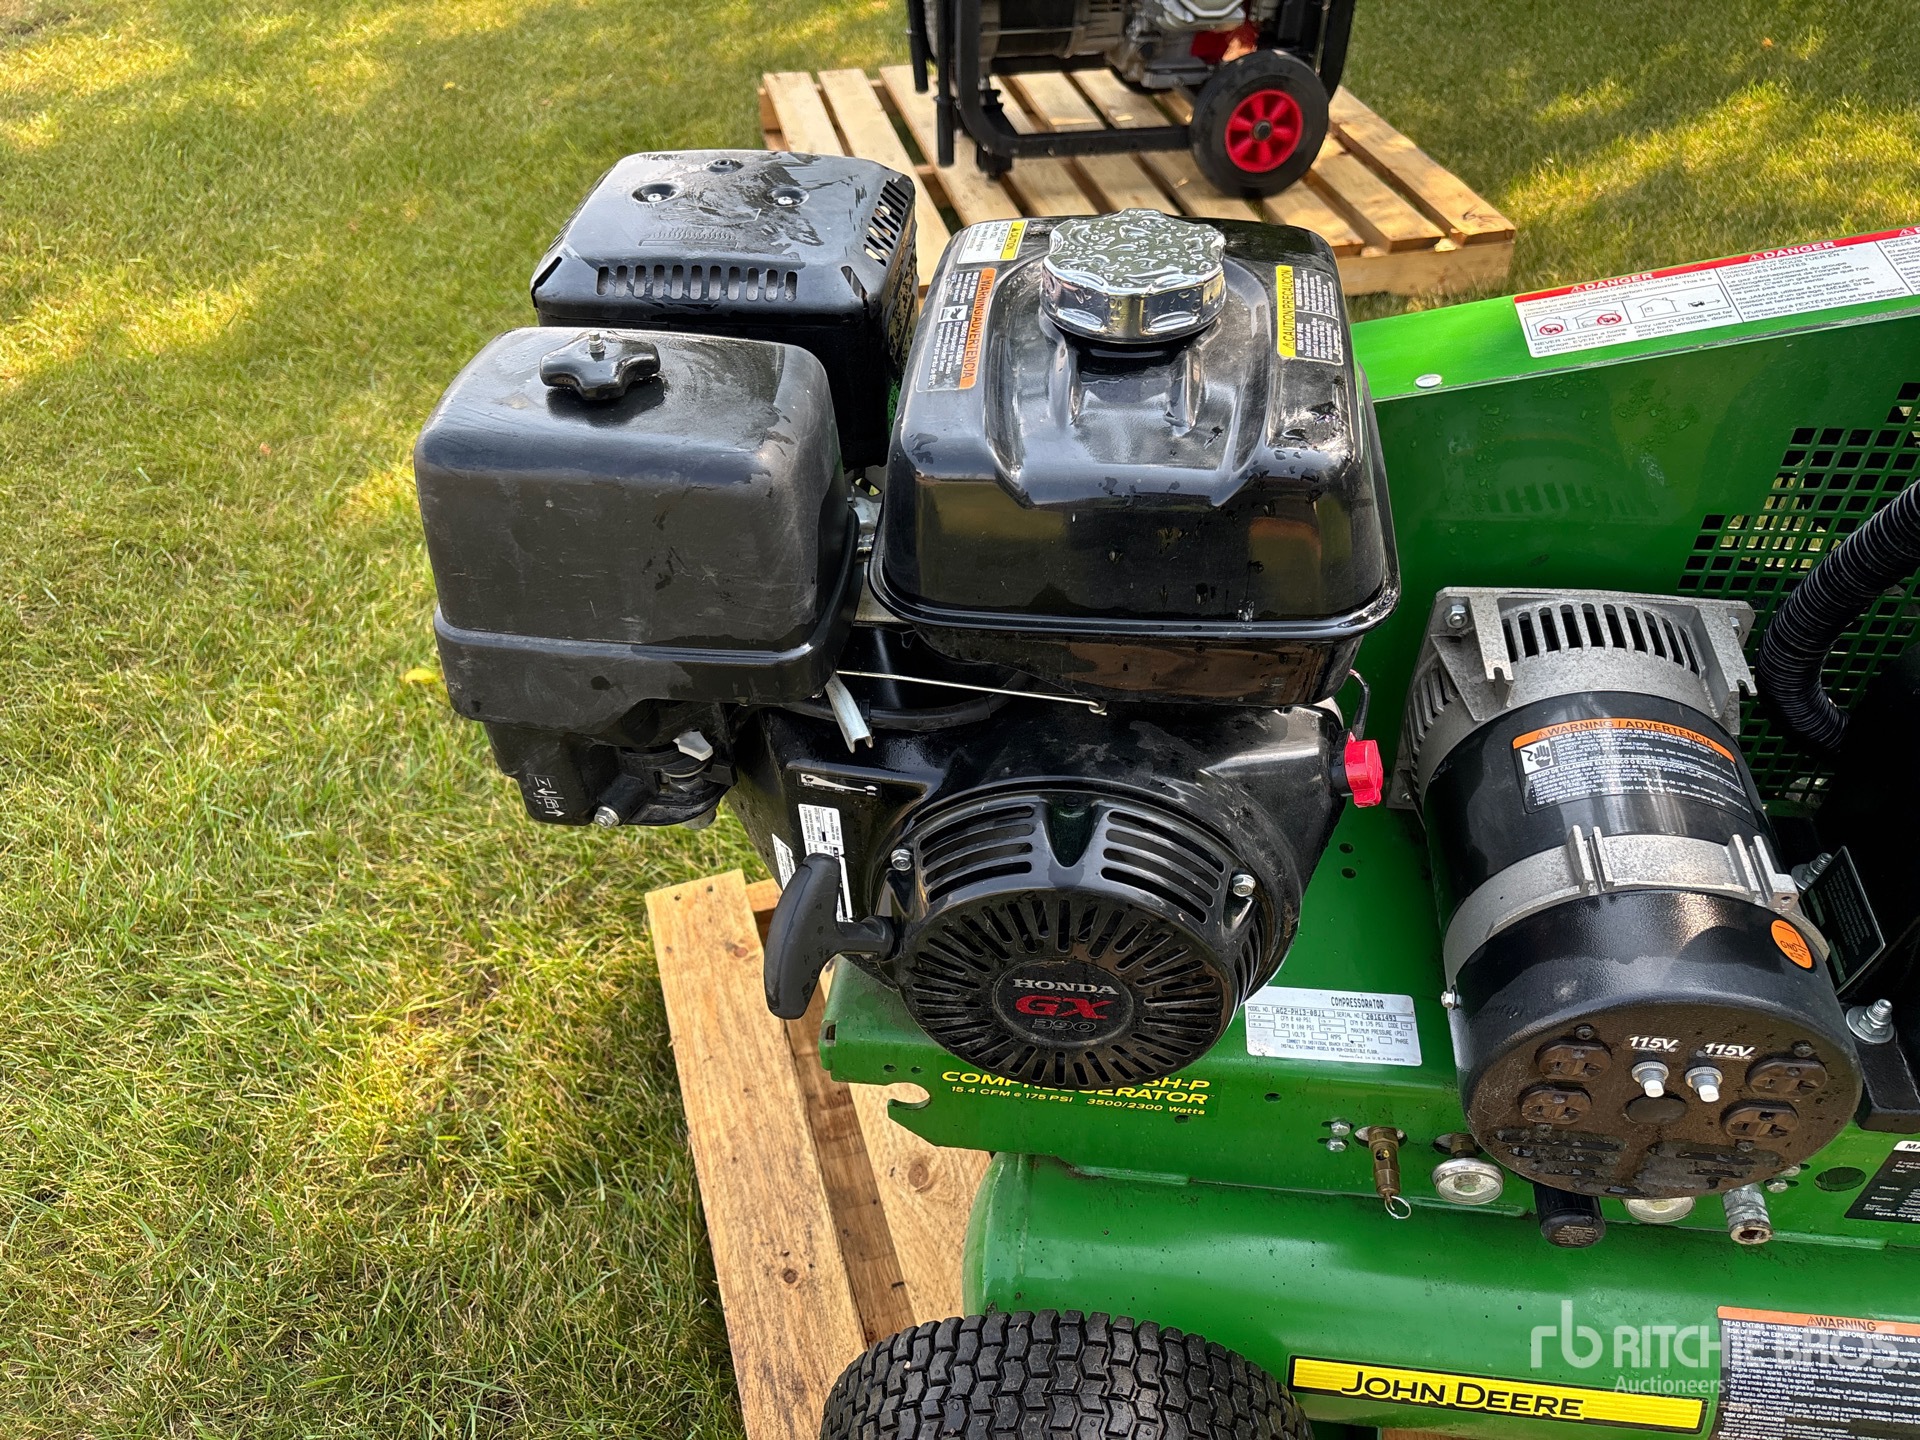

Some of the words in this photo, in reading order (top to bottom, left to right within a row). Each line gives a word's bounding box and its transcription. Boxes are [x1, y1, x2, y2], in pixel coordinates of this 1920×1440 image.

[1763, 242, 1836, 258] DANGER
[1584, 273, 1654, 290] DANGER
[1547, 720, 1614, 736] WARNING
[1625, 720, 1714, 749] ADVERTENCIA
[1780, 940, 1798, 952] GND
[1013, 978, 1120, 996] HONDA
[1015, 995, 1115, 1020] GX
[1330, 996, 1384, 1010] COMPRESSORATOR
[1032, 1018, 1096, 1032] 390
[1630, 1036, 1678, 1050] 115V
[1704, 1043, 1755, 1057] 115V
[980, 1088, 1010, 1097] CFM
[1049, 1094, 1074, 1102] PSI
[1086, 1098, 1164, 1111] 3500/2300
[1168, 1106, 1206, 1115] Watts
[1742, 1322, 1766, 1330] ENTIRE
[1766, 1323, 1808, 1334] INSTRUCTION
[1810, 1328, 1838, 1337] MANUAL
[1838, 1331, 1866, 1339] BEFORE
[1866, 1334, 1904, 1342] OPERATING
[1816, 1316, 1876, 1332] WARNING
[1342, 1372, 1446, 1402] JOHN
[1456, 1382, 1584, 1417] DEERE
